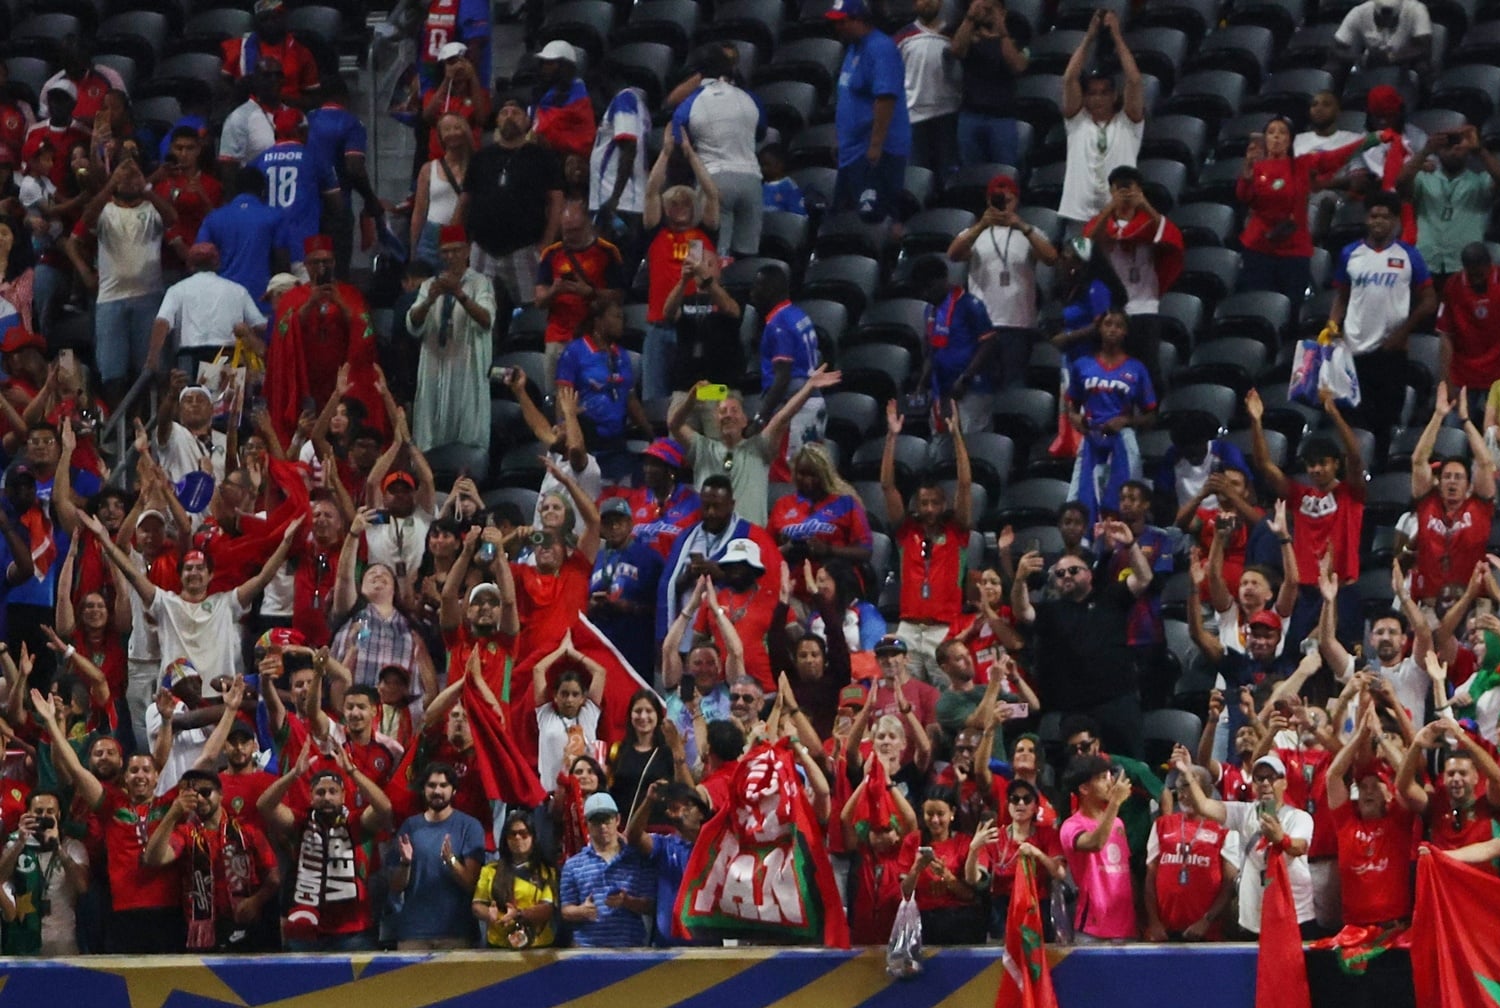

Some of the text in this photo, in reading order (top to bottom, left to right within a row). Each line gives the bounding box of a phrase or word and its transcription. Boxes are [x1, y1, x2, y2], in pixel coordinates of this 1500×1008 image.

[264, 151, 303, 161] ISIDOR
[266, 165, 298, 208] 18
[1355, 271, 1399, 289] HAITI
[1159, 850, 1211, 867] Emiates
